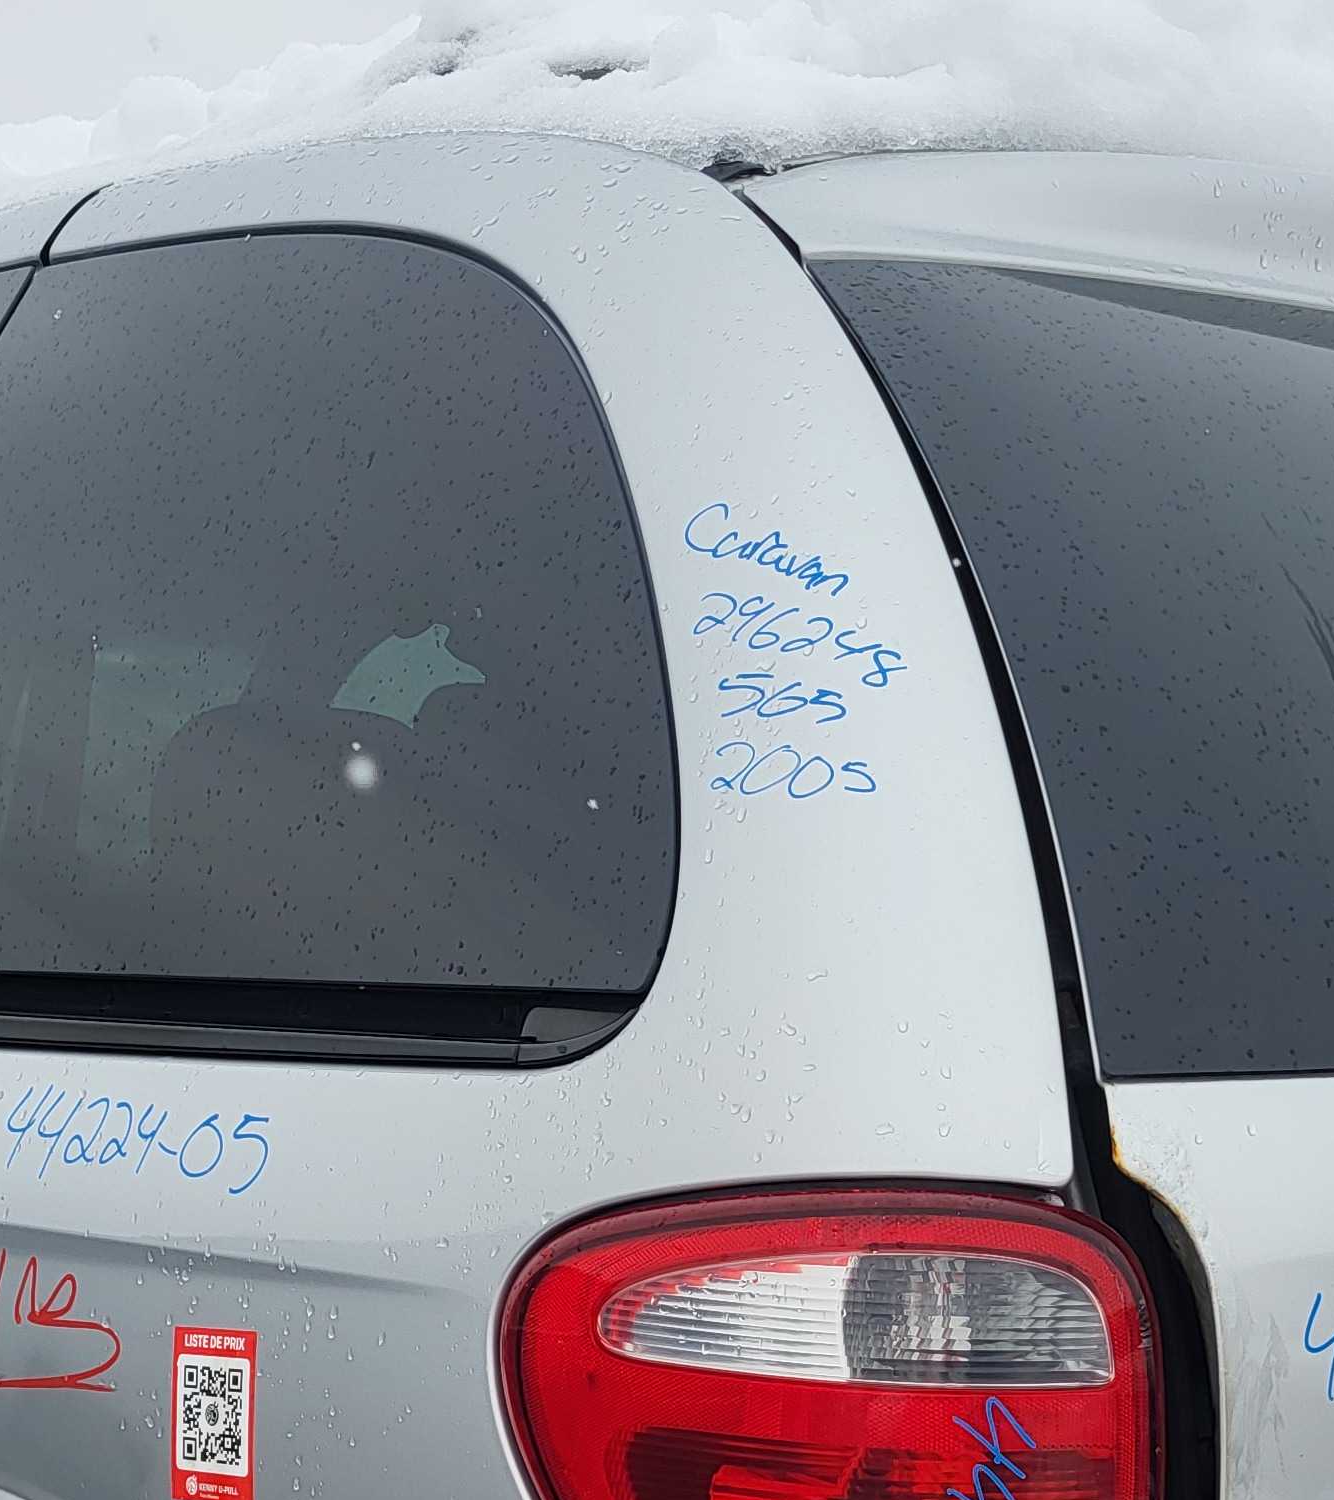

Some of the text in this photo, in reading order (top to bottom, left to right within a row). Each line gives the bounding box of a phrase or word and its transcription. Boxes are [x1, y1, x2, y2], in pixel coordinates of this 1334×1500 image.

[693, 592, 908, 688] 296248
[710, 741, 877, 799] 2005
[184, 1333, 246, 1351] LISTE DE PRIX
